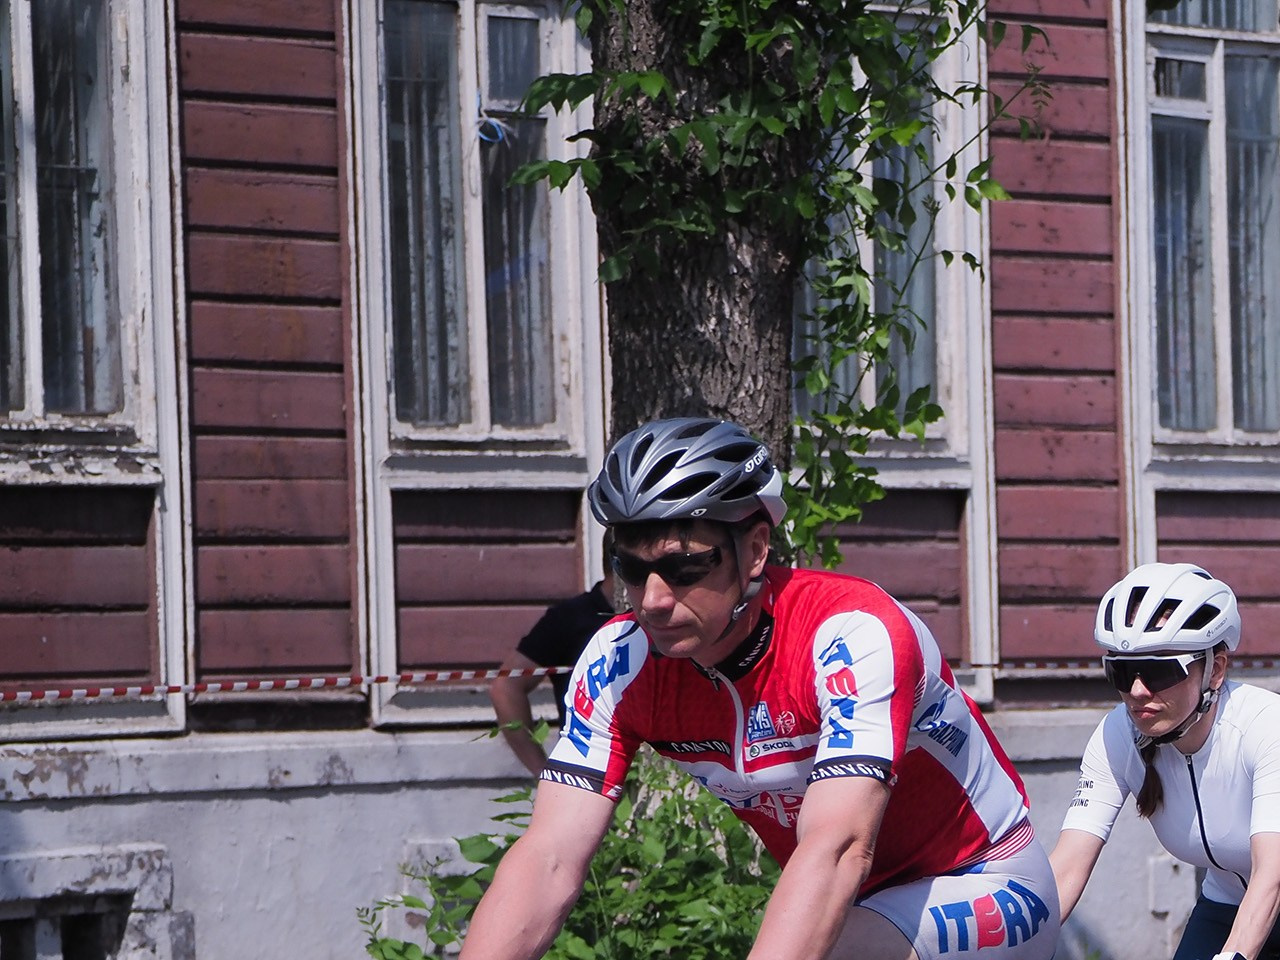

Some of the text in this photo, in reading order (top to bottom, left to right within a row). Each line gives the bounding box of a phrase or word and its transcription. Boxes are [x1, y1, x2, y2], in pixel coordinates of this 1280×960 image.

[762, 741, 796, 752] ŠKODA
[540, 768, 594, 791] NYON
[811, 763, 885, 781] CANYON
[928, 879, 1050, 954] ITERA
